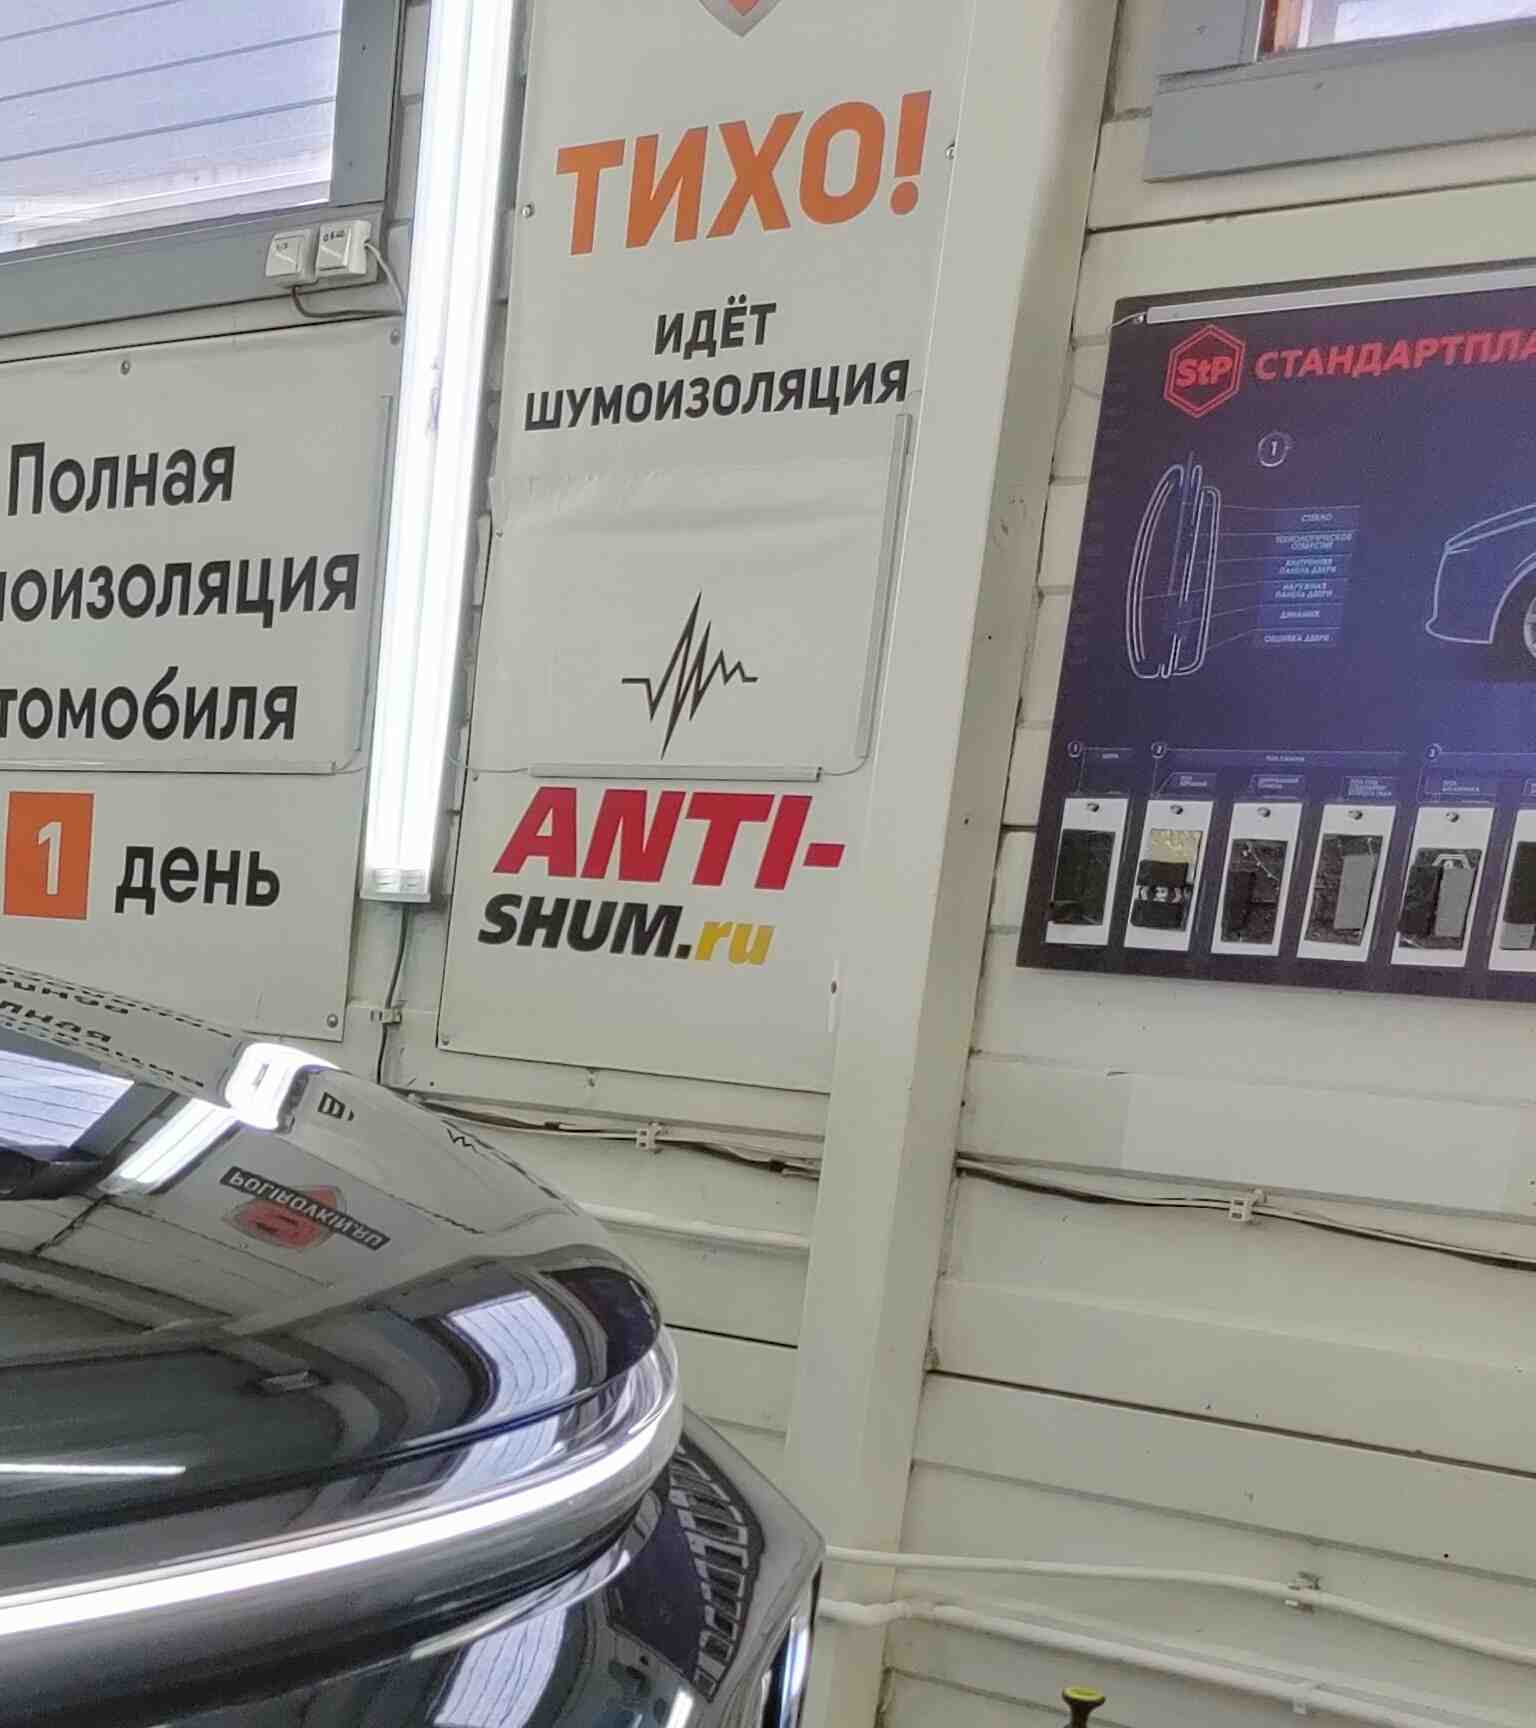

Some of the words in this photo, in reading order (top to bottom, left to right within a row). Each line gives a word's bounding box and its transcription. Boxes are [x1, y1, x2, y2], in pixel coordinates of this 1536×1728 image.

[555, 91, 930, 256] ТИХО!
[653, 294, 778, 359] ИДЁТ
[525, 358, 910, 431] ШУМОИЗОЛЯЦИЯ
[1174, 354, 1234, 388] StP
[7, 441, 236, 516] Полная
[37, 821, 62, 896] 1
[113, 844, 281, 916] день
[494, 785, 846, 890] ANTI-
[477, 893, 773, 966] SHUM.ru
